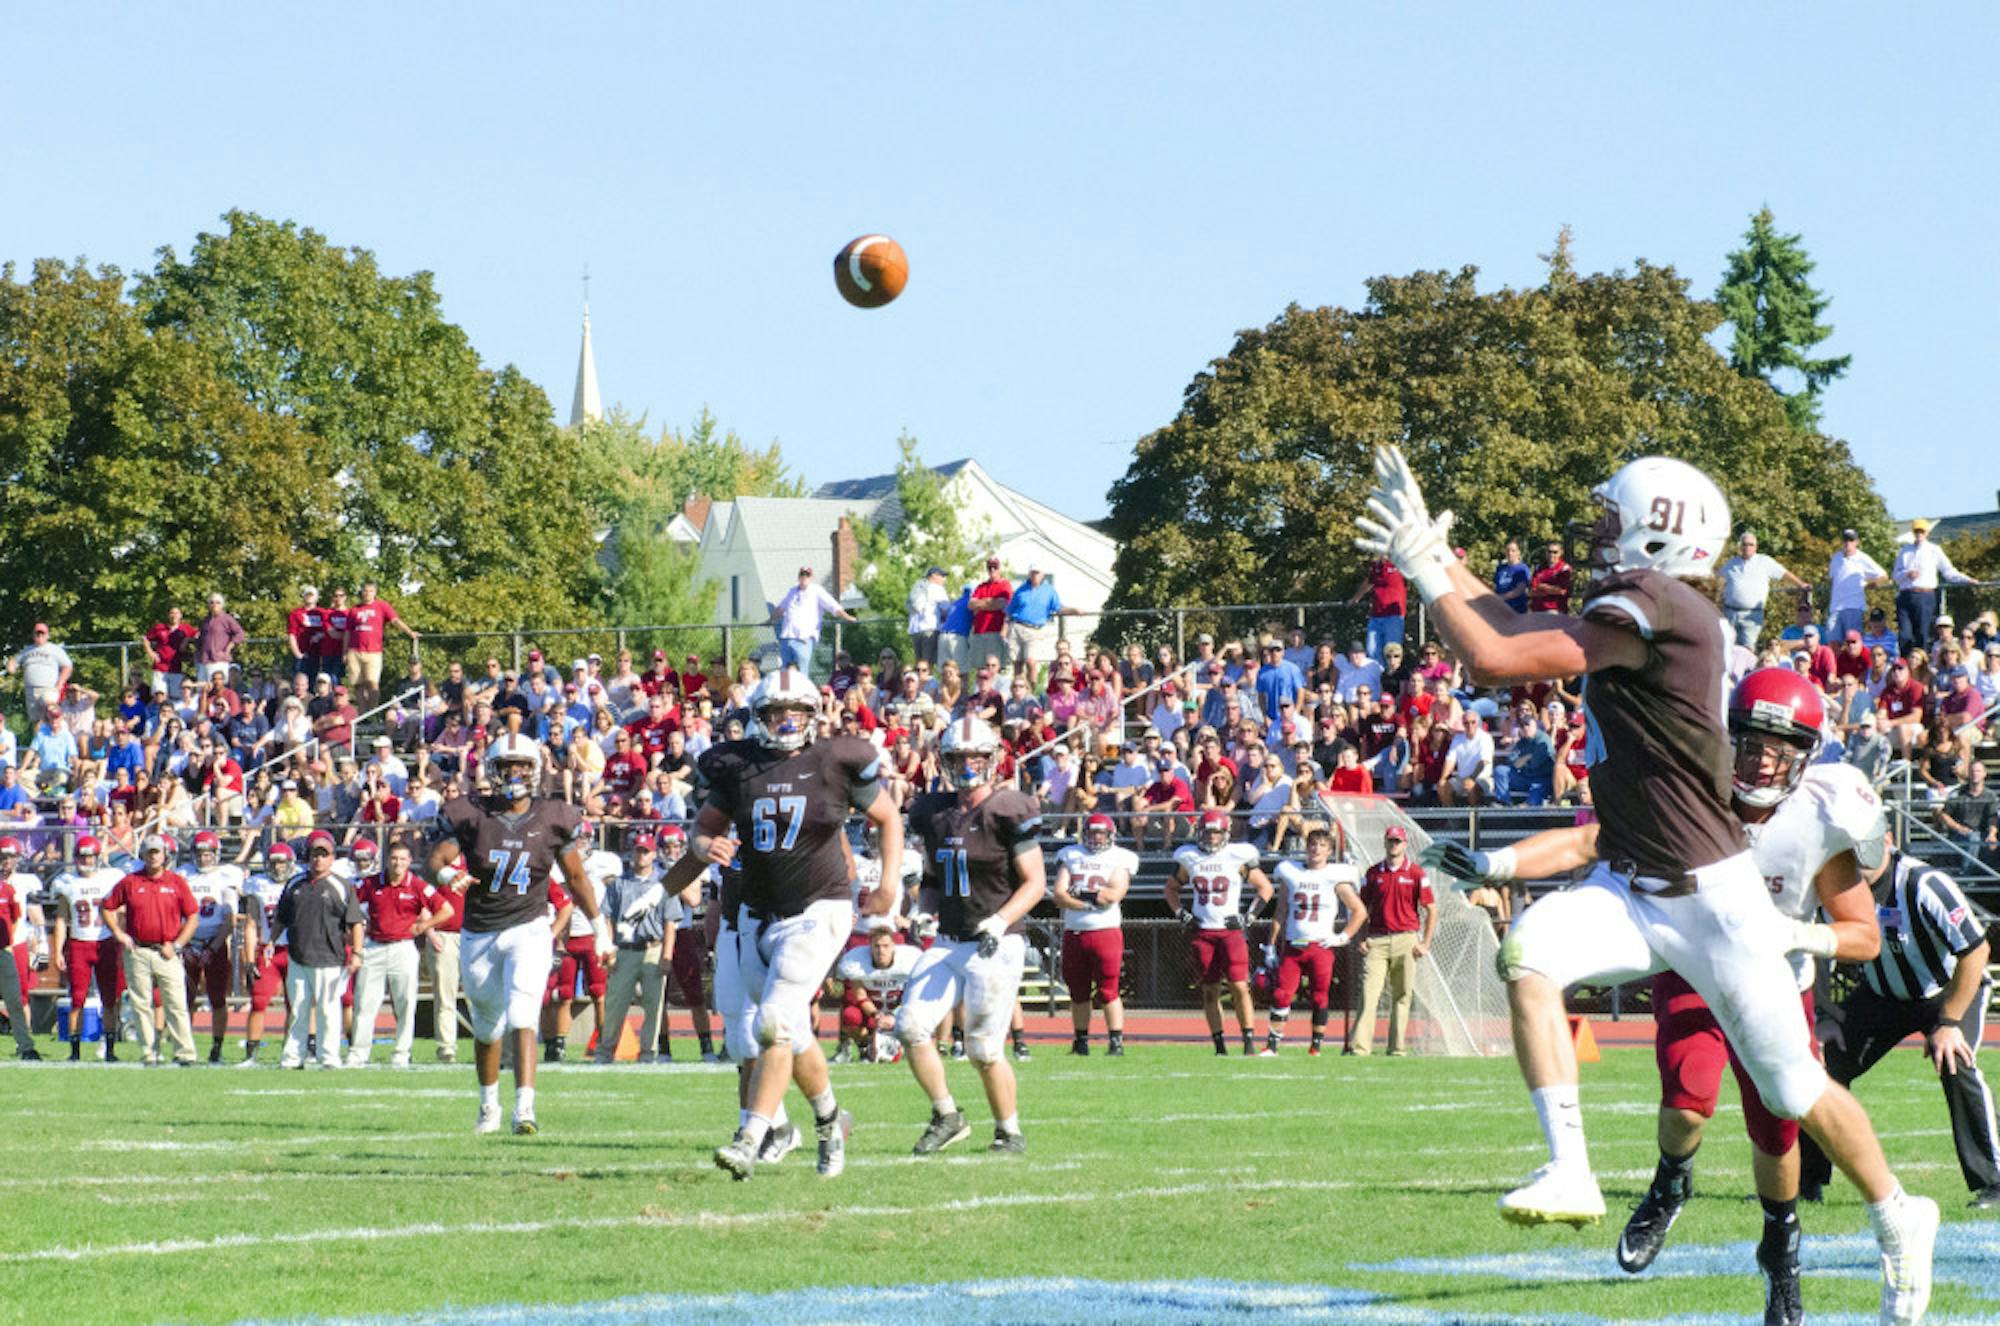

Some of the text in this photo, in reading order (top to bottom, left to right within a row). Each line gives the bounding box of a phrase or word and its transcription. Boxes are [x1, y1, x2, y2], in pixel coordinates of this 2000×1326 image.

[1648, 496, 1685, 534] 91
[752, 795, 807, 852] 67
[489, 849, 531, 895] 74
[935, 849, 971, 897] 71
[1193, 875, 1230, 906] 99
[1294, 892, 1321, 922] 31
